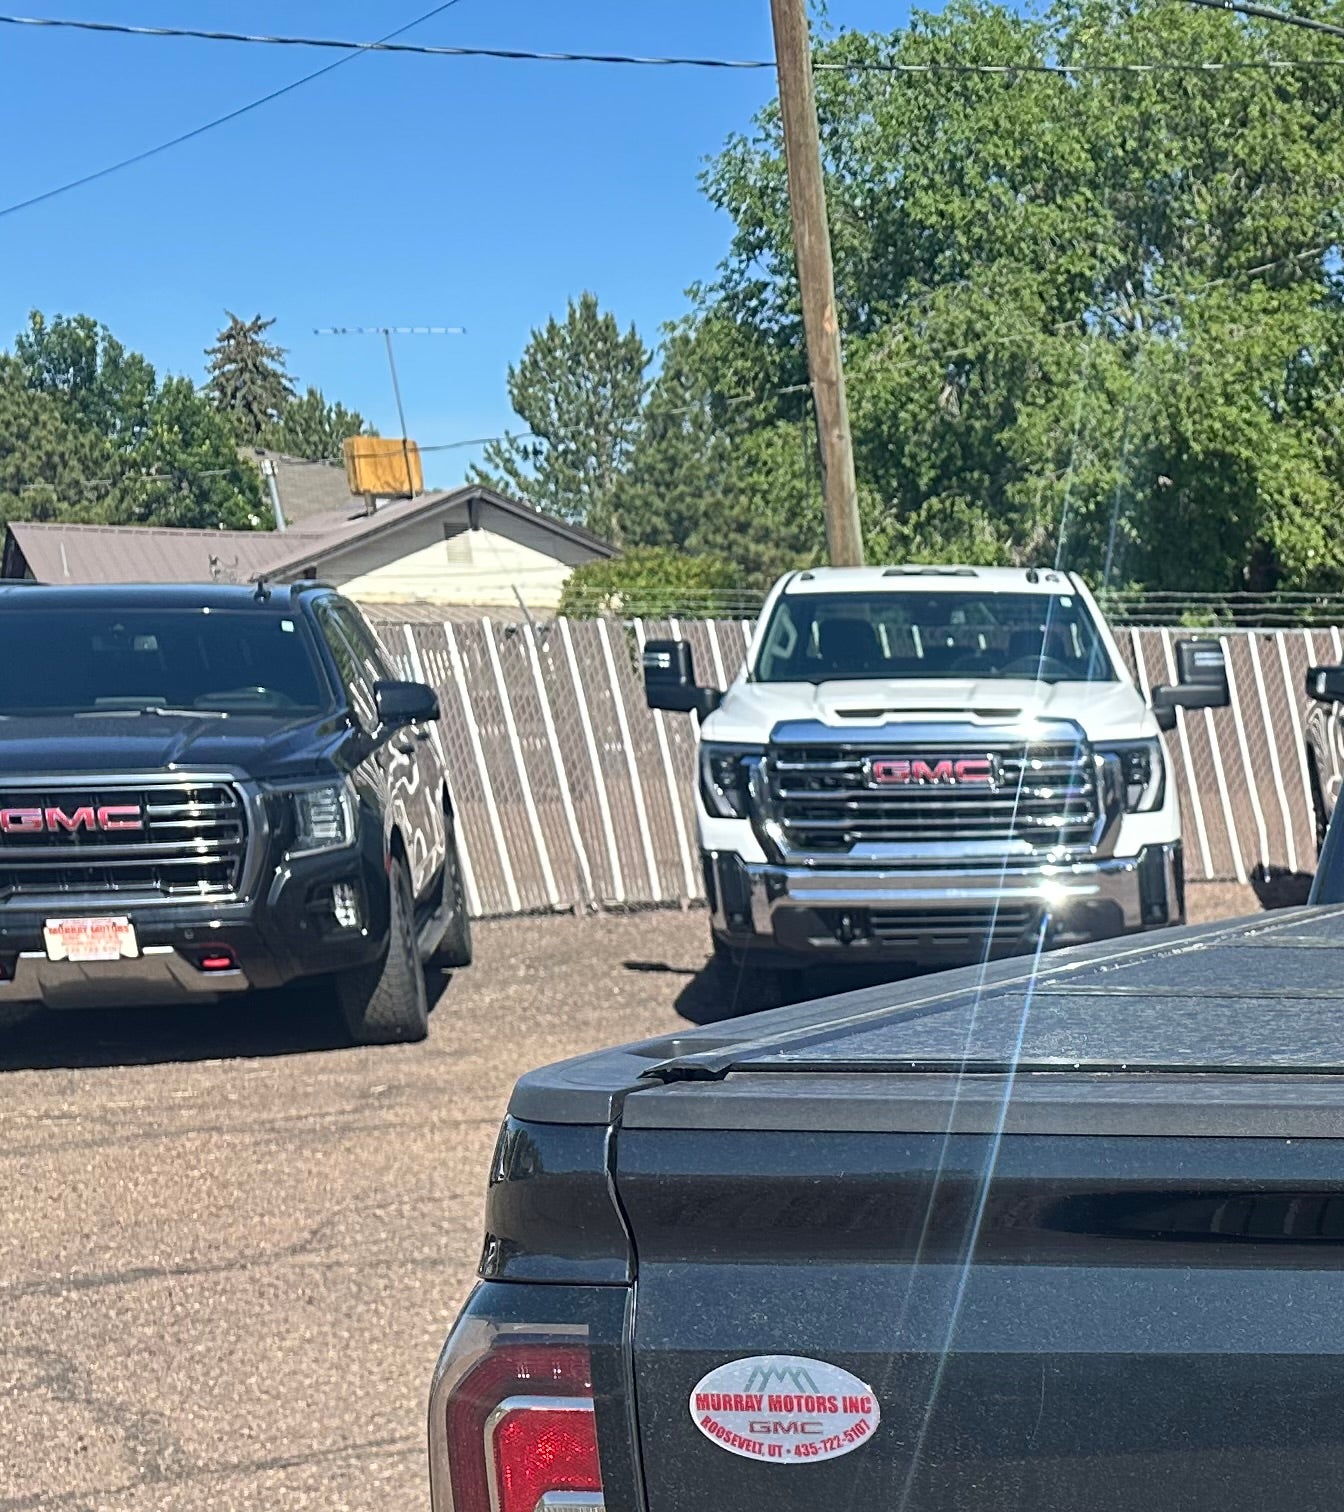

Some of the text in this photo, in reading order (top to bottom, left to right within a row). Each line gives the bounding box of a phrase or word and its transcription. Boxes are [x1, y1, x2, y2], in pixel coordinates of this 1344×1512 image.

[872, 760, 992, 784] GMC
[0, 805, 144, 833] GMC
[695, 1393, 872, 1415] MURRAY MOTORS INC
[700, 1415, 871, 1458] ROOSEVELT, UT 435-722-5107
[749, 1420, 824, 1435] GMC
